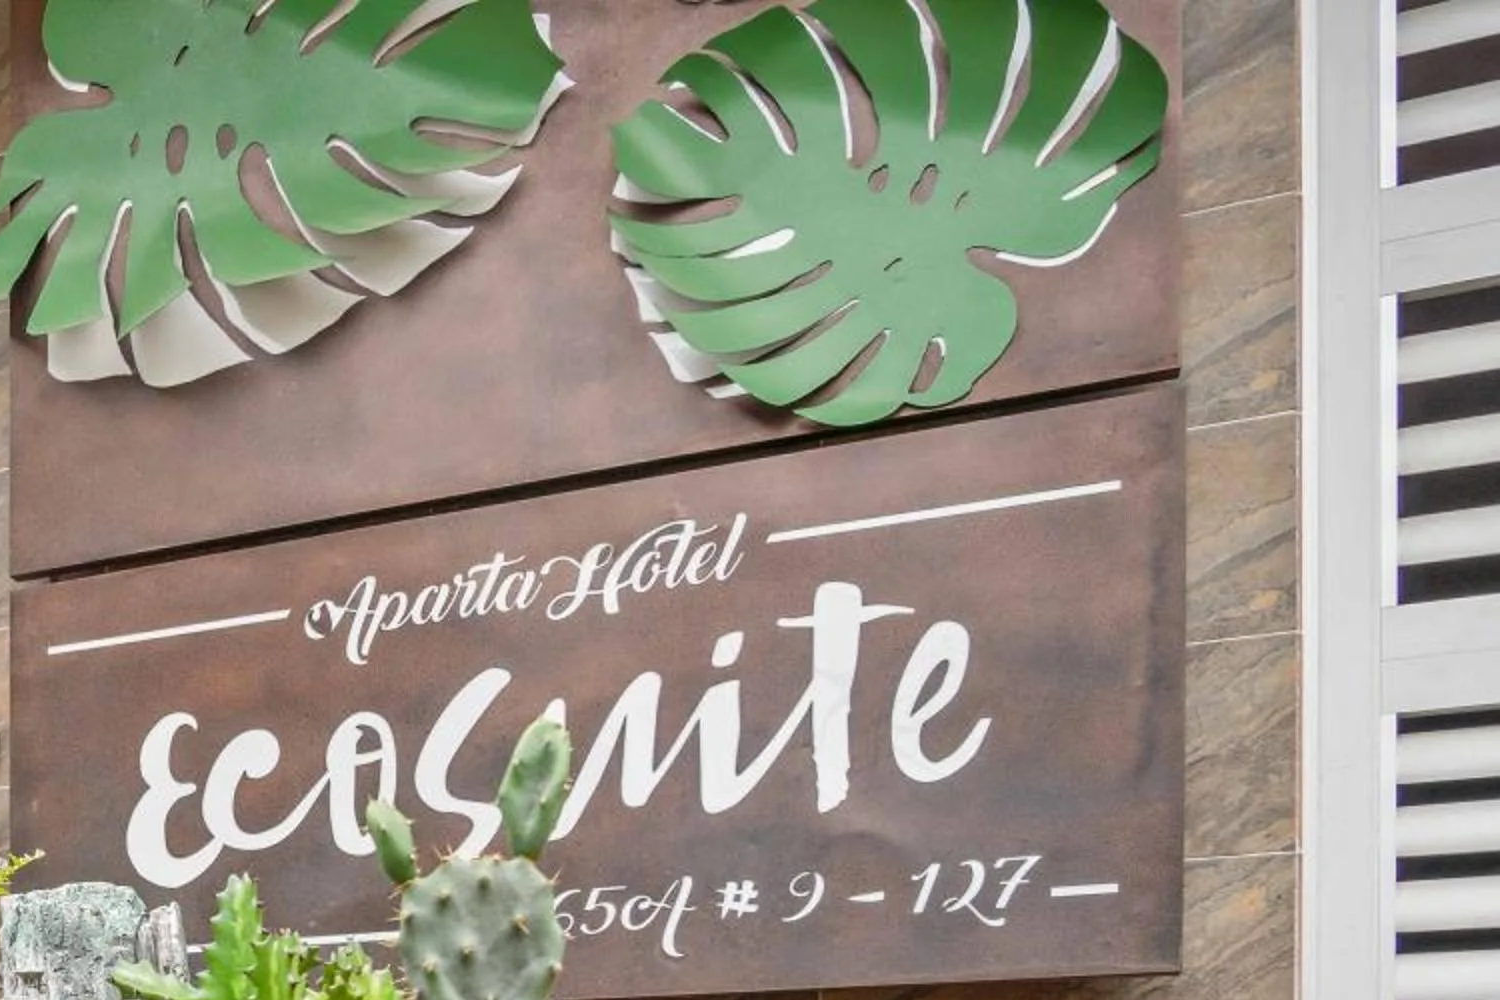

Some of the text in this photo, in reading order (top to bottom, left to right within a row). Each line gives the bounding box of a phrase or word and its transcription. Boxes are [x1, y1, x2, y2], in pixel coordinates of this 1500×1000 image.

[303, 512, 748, 666] Aparta Hotel
[716, 879, 760, 920] #
[782, 871, 825, 922] 9
[911, 854, 1043, 928] 127
